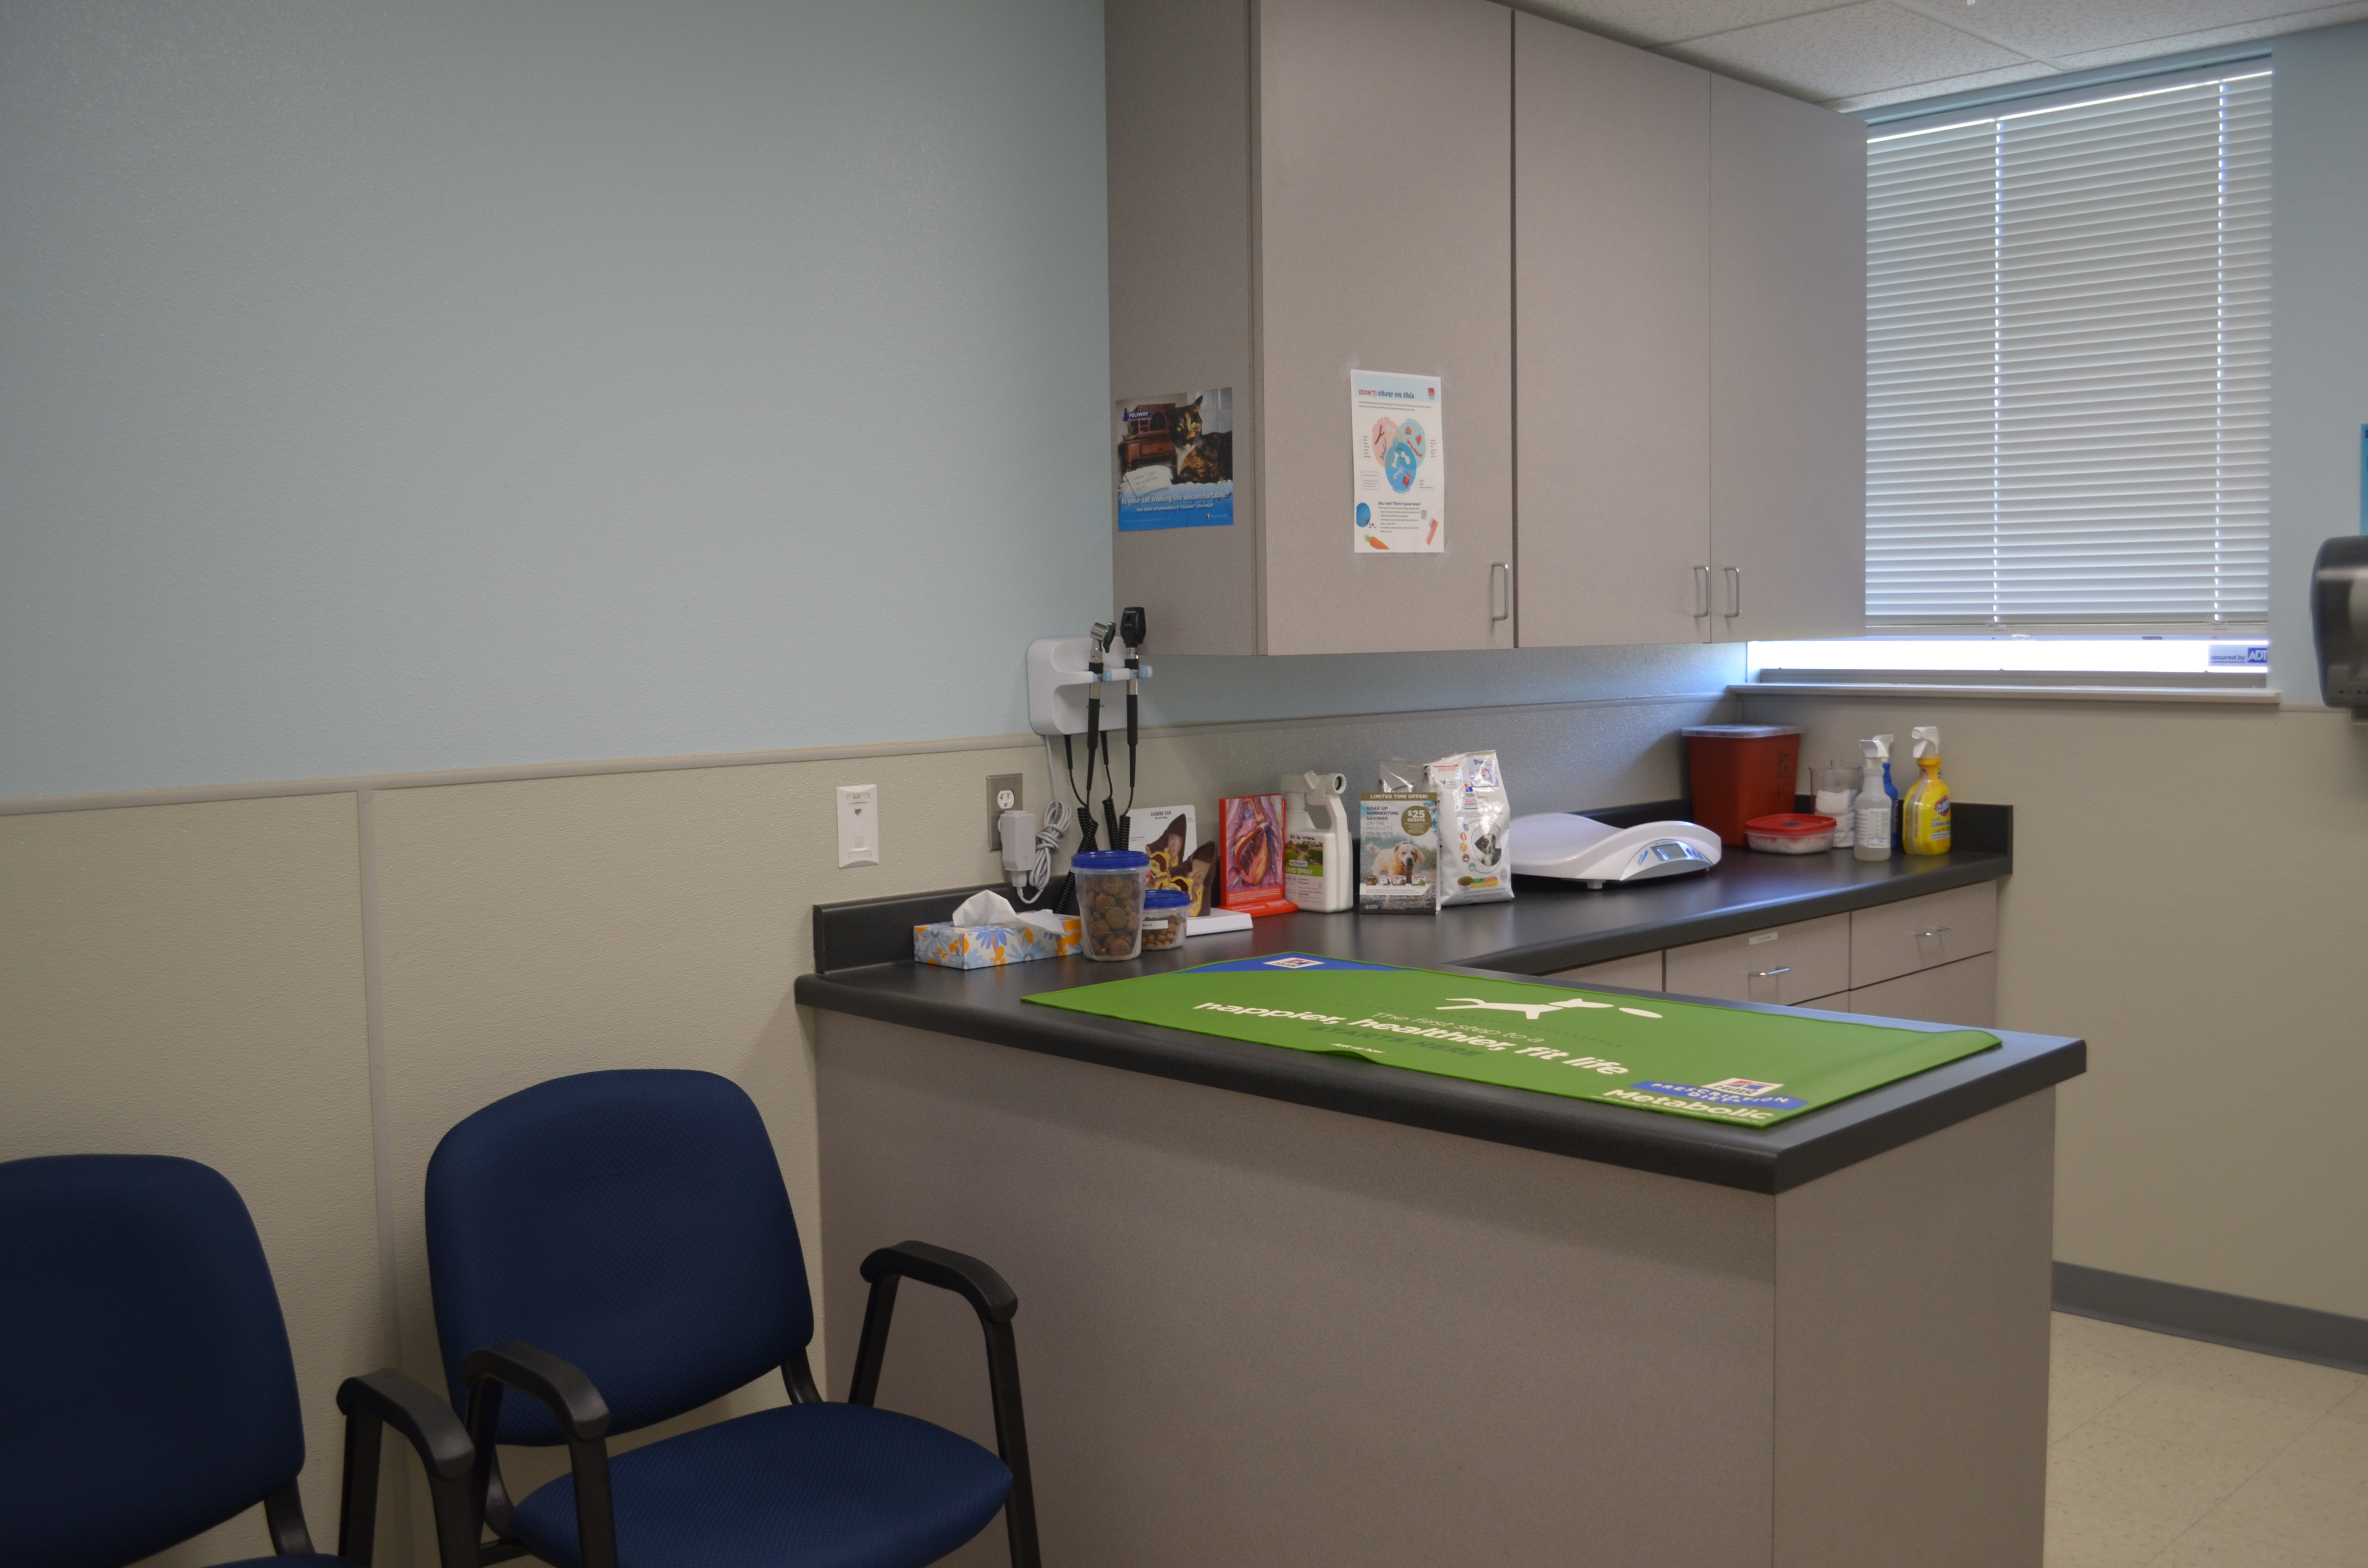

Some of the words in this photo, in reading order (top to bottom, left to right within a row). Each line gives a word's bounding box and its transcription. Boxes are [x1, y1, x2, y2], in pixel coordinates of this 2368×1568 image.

[1184, 490, 1229, 501] uncomfortable?
[2248, 650, 2267, 661] ADT
[1407, 809, 1425, 818] $25
[1371, 1012, 1409, 1021] The
[1410, 1017, 1455, 1026] first
[1453, 1024, 1501, 1035] step
[1192, 1002, 1347, 1025] happier,
[1346, 1018, 1517, 1051] healthier,
[1514, 1046, 1570, 1060] fit
[1561, 1056, 1629, 1075] life
[1308, 1026, 1410, 1043] STARTS
[1411, 1040, 1484, 1057] HERE
[1651, 1082, 1789, 1103] PRESCRIPTION
[1602, 1089, 1774, 1120] Metabolic
